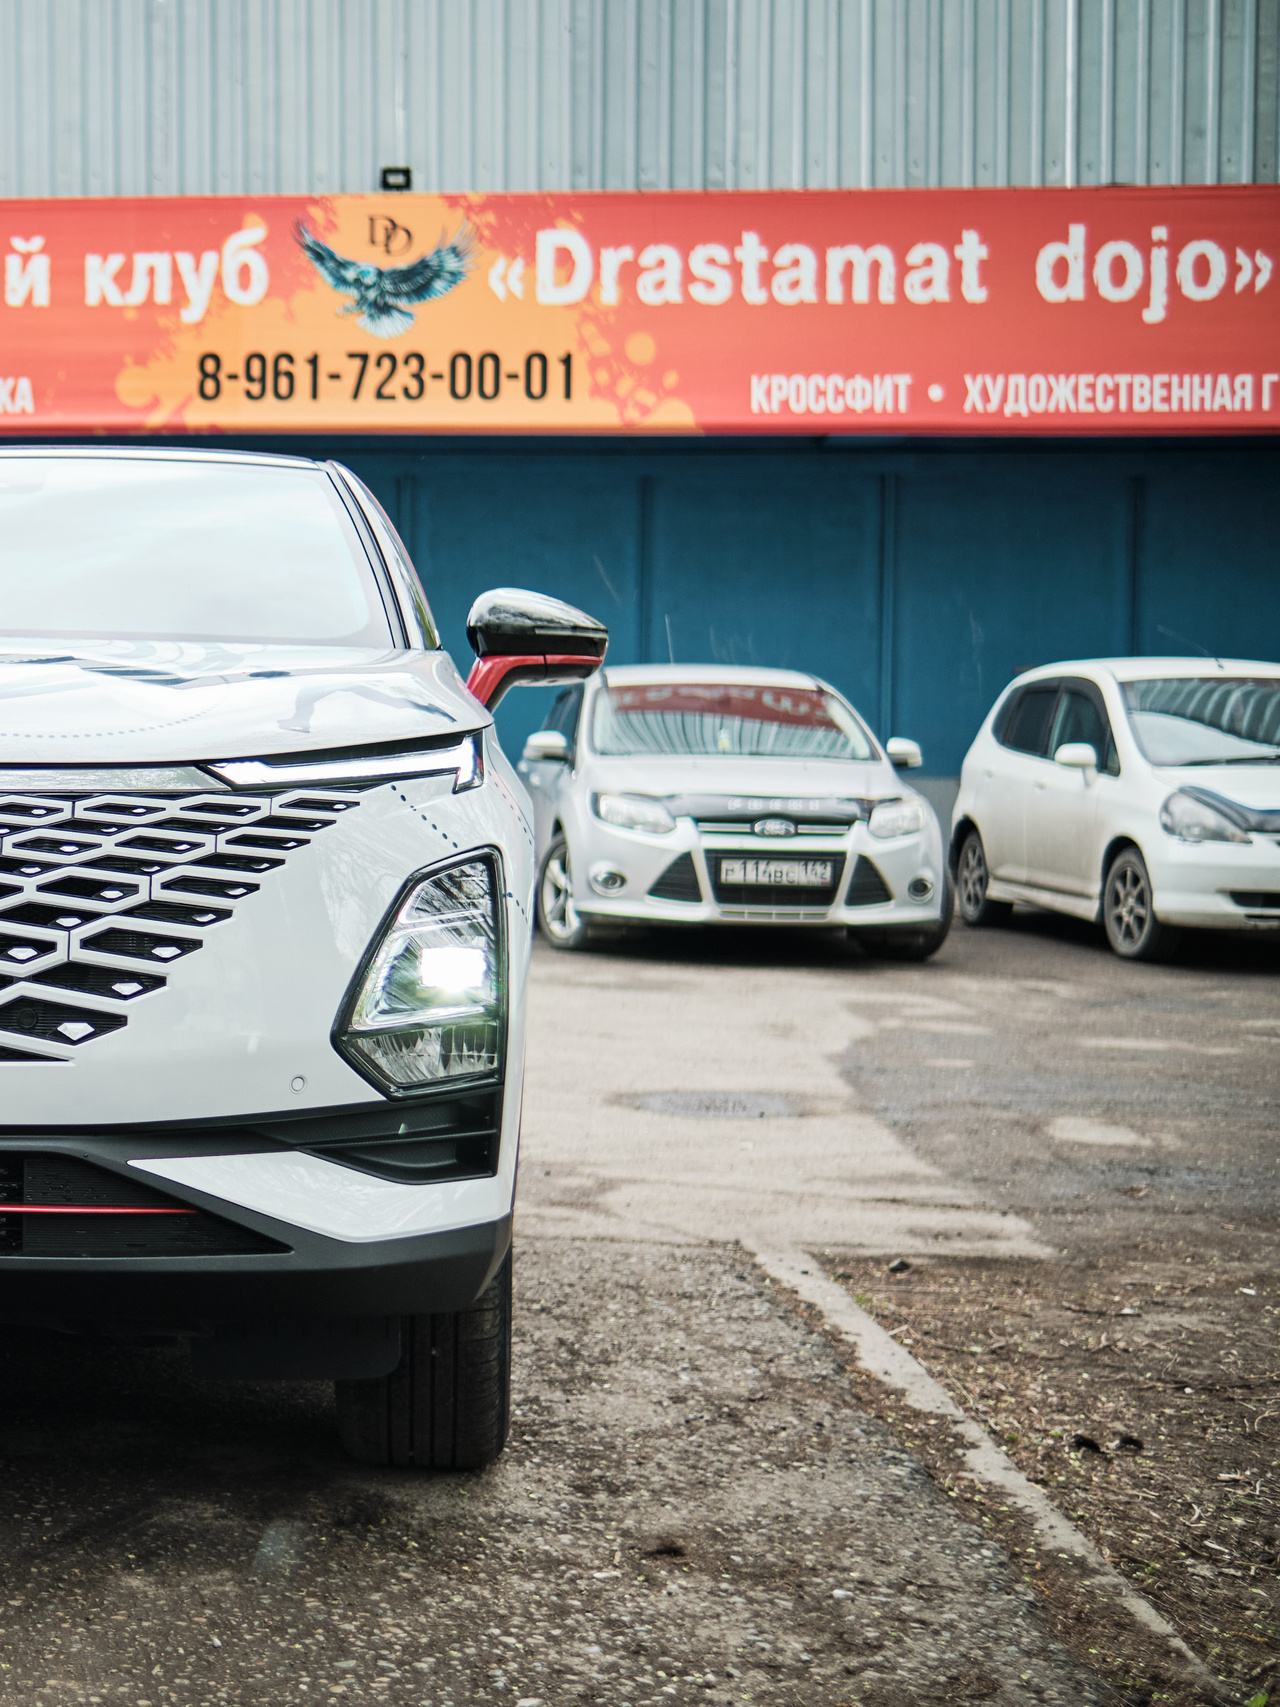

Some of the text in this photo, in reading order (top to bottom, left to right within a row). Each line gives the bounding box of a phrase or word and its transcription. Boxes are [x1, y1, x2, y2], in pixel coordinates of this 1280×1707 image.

[84, 226, 270, 324] клуб
[487, 228, 989, 307] «Drastamat
[1034, 223, 1274, 324] dojo»
[198, 352, 573, 402] 8-961-723-00-01
[748, 372, 913, 415] КРОССФИТ
[962, 371, 1253, 417] ХУДОЖЕСТВЕННАЯ
